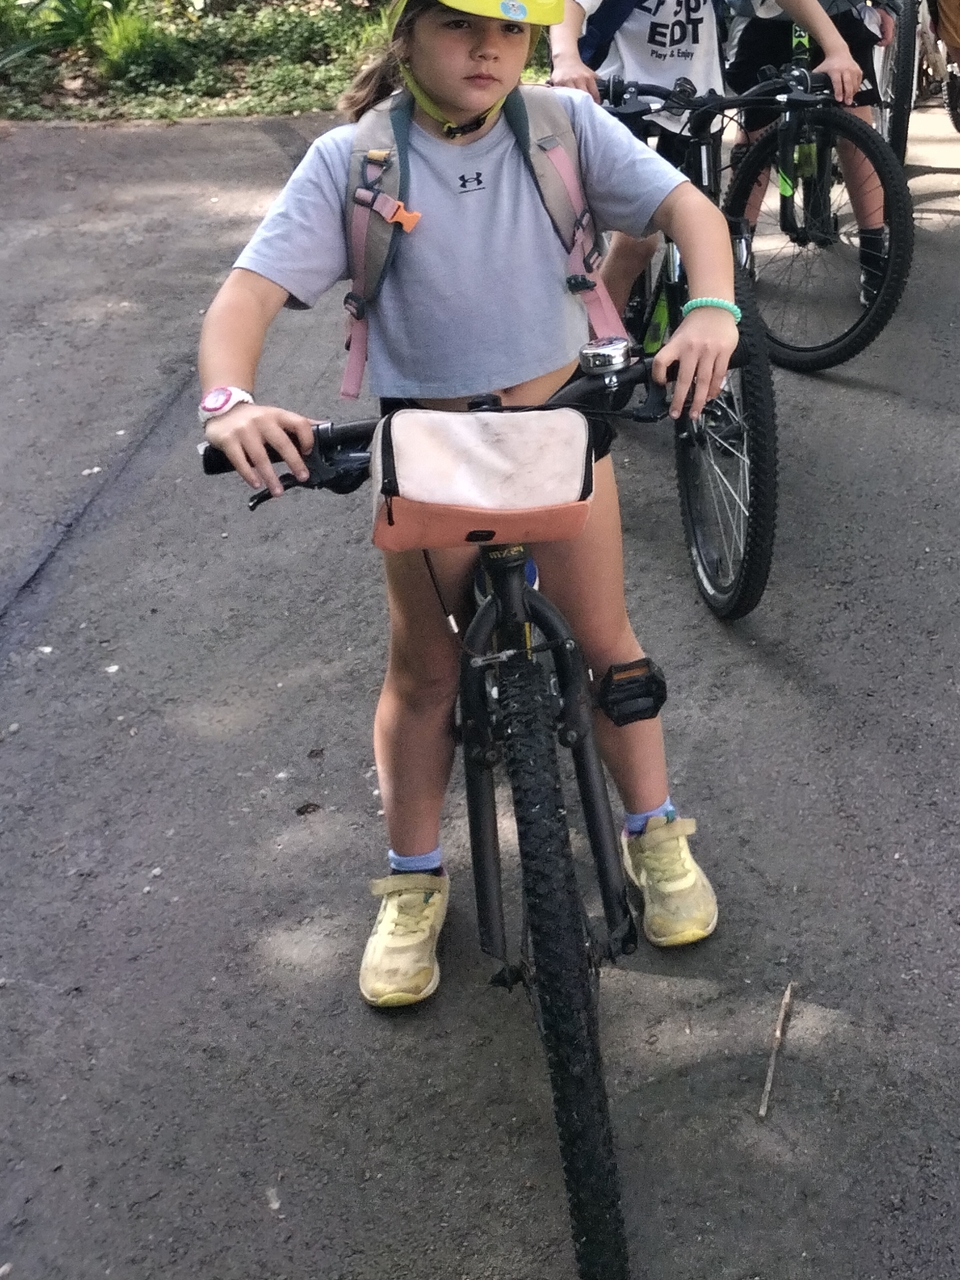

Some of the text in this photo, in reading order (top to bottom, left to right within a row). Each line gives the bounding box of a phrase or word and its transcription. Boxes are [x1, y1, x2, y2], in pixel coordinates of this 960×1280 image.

[647, 19, 703, 47] EDT
[650, 48, 695, 62] Play & Enjoy
